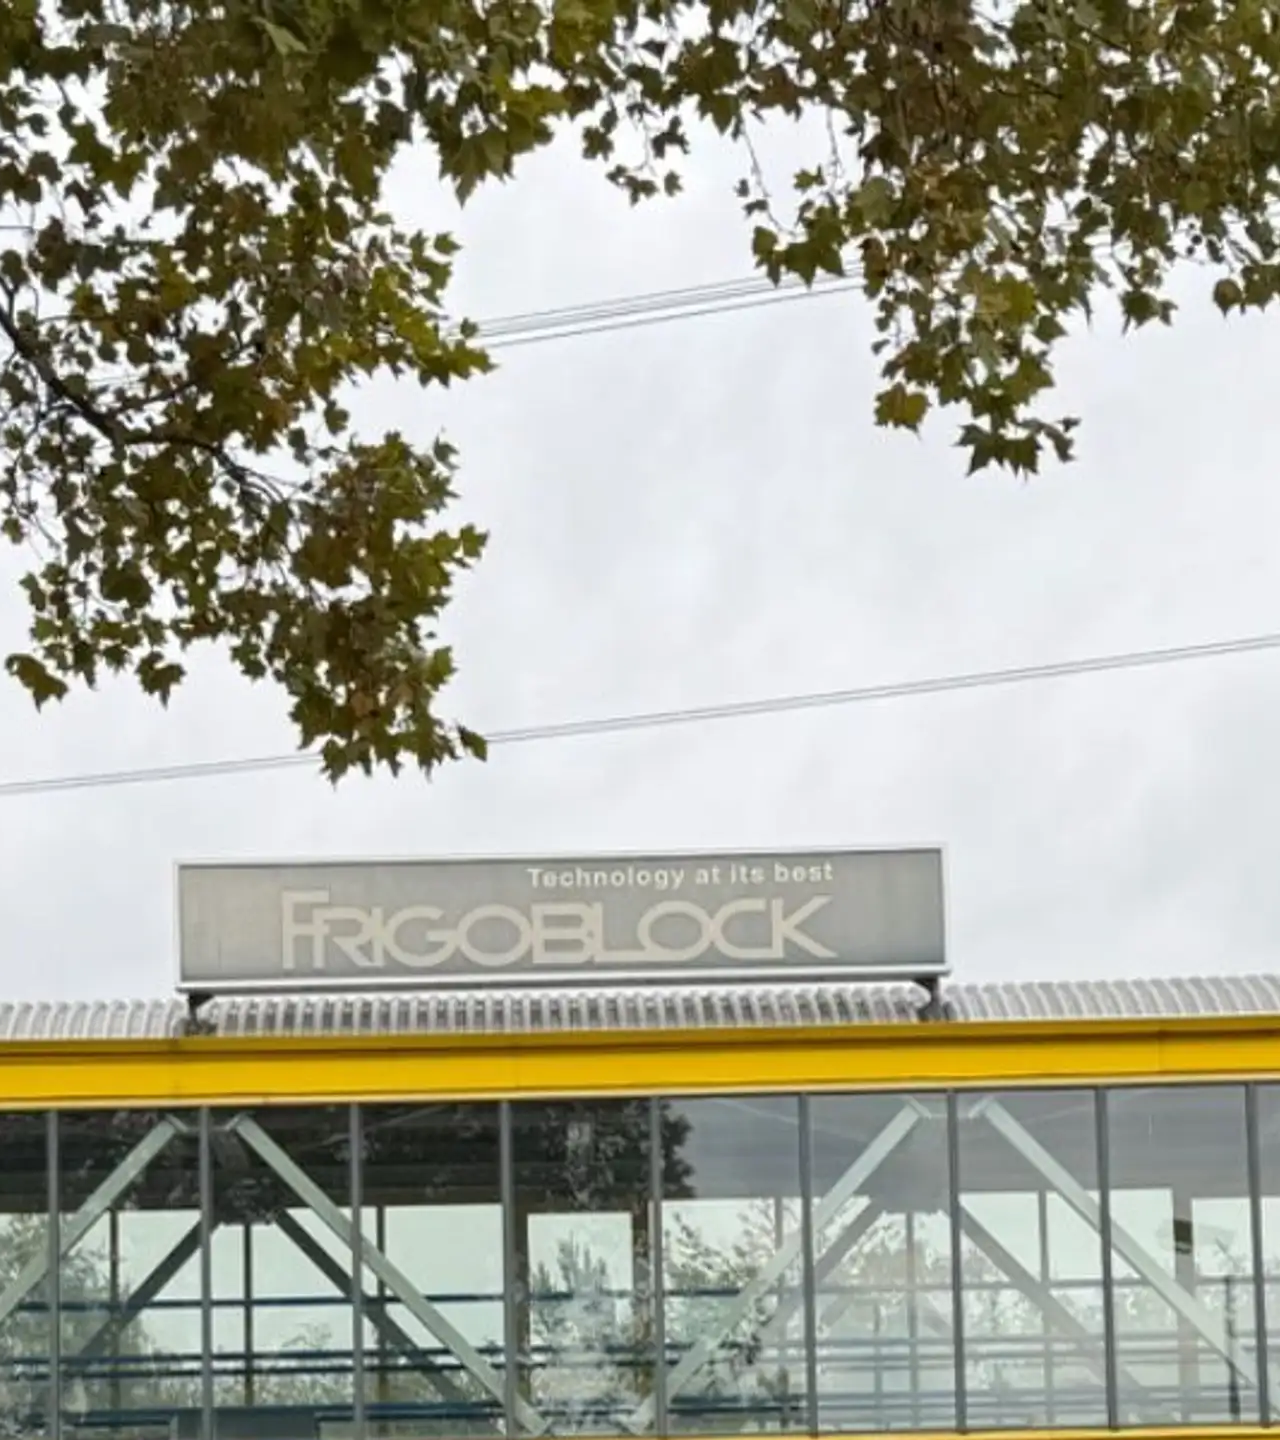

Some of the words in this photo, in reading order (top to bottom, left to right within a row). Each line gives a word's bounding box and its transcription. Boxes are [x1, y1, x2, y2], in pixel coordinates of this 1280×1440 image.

[526, 867, 685, 889] Technology
[695, 866, 721, 885] at
[730, 862, 765, 884] its
[773, 861, 834, 883] best
[281, 889, 839, 969] FRIGOBLOCK
